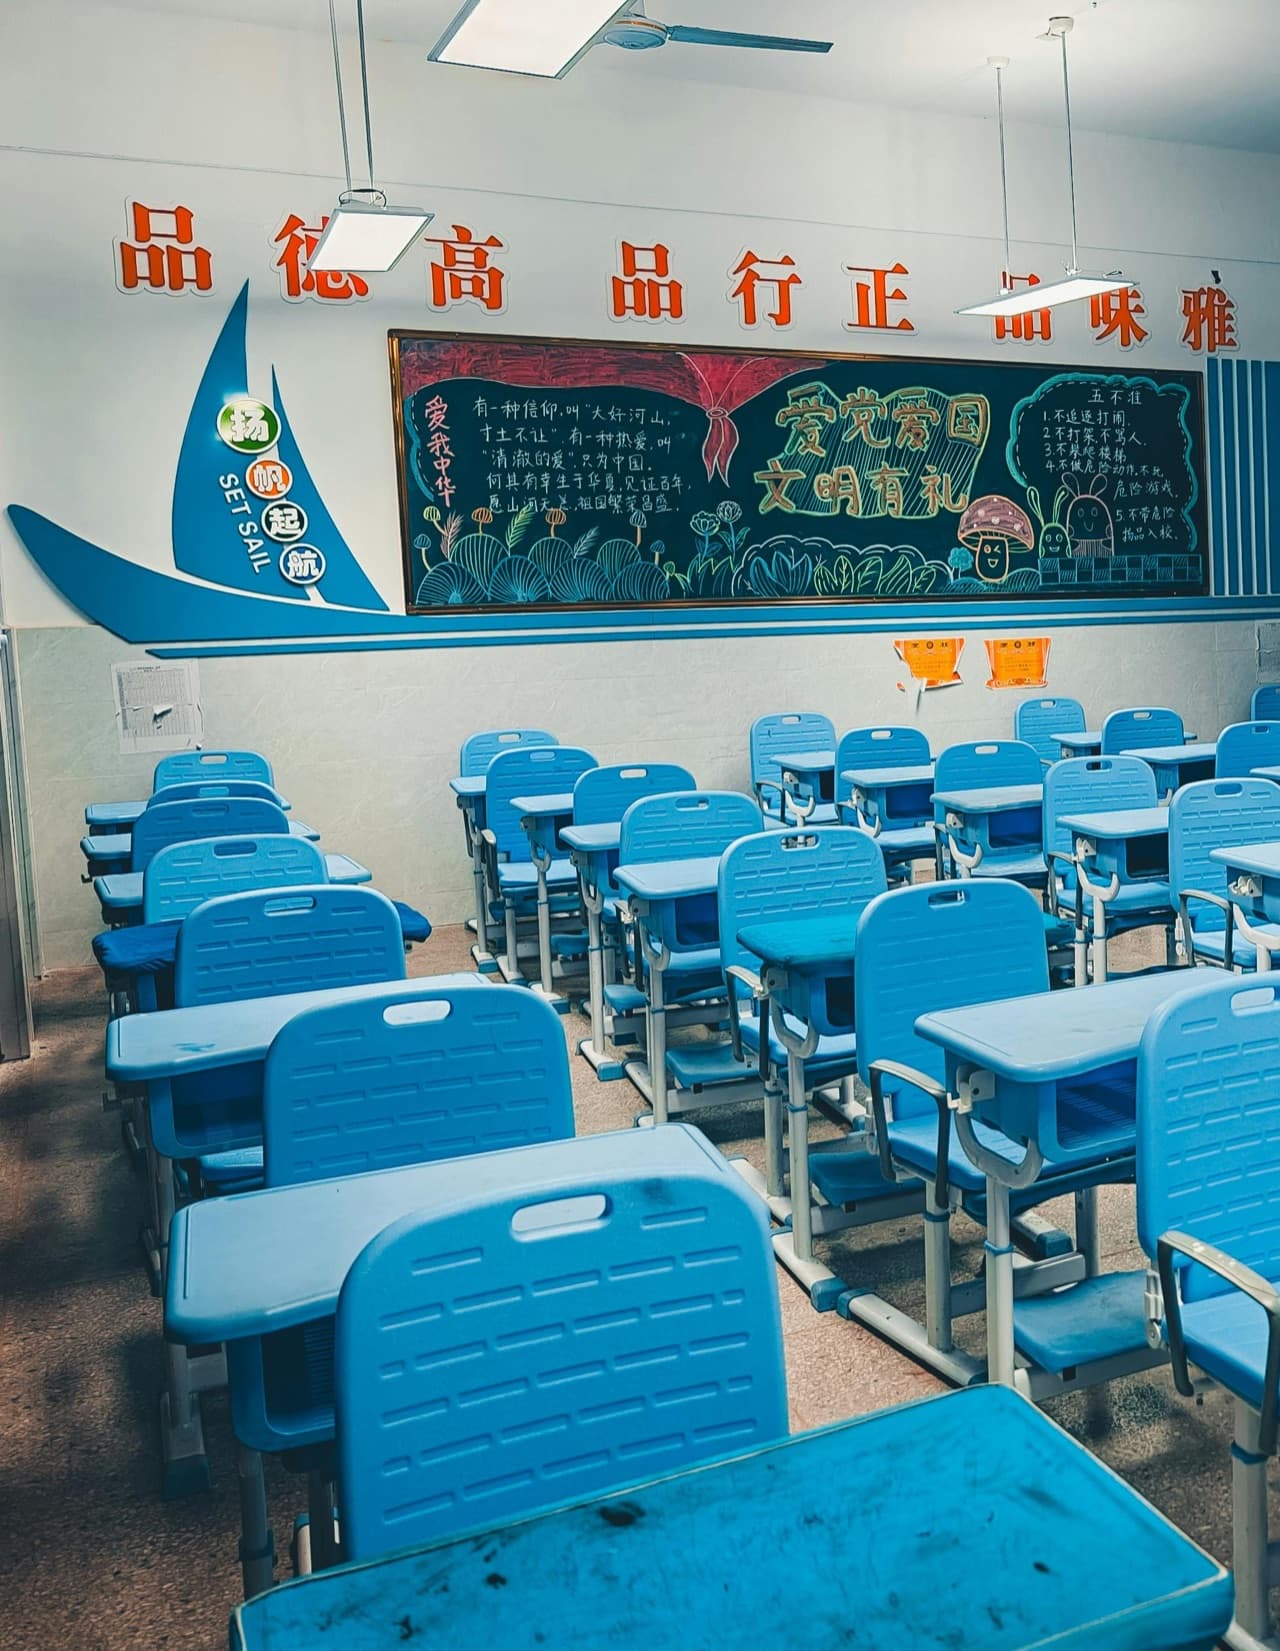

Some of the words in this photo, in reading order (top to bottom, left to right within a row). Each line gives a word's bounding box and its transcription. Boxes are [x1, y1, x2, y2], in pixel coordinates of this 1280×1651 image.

[611, 241, 915, 330] 品行正
[776, 382, 989, 457] 爱党爱国
[1088, 388, 1143, 405] 五不准
[229, 407, 320, 578] 扬帆起航
[424, 394, 456, 507] 爱我中华
[754, 459, 968, 518] 文明有礼
[219, 473, 252, 517] SET
[238, 521, 272, 573] SAIL
